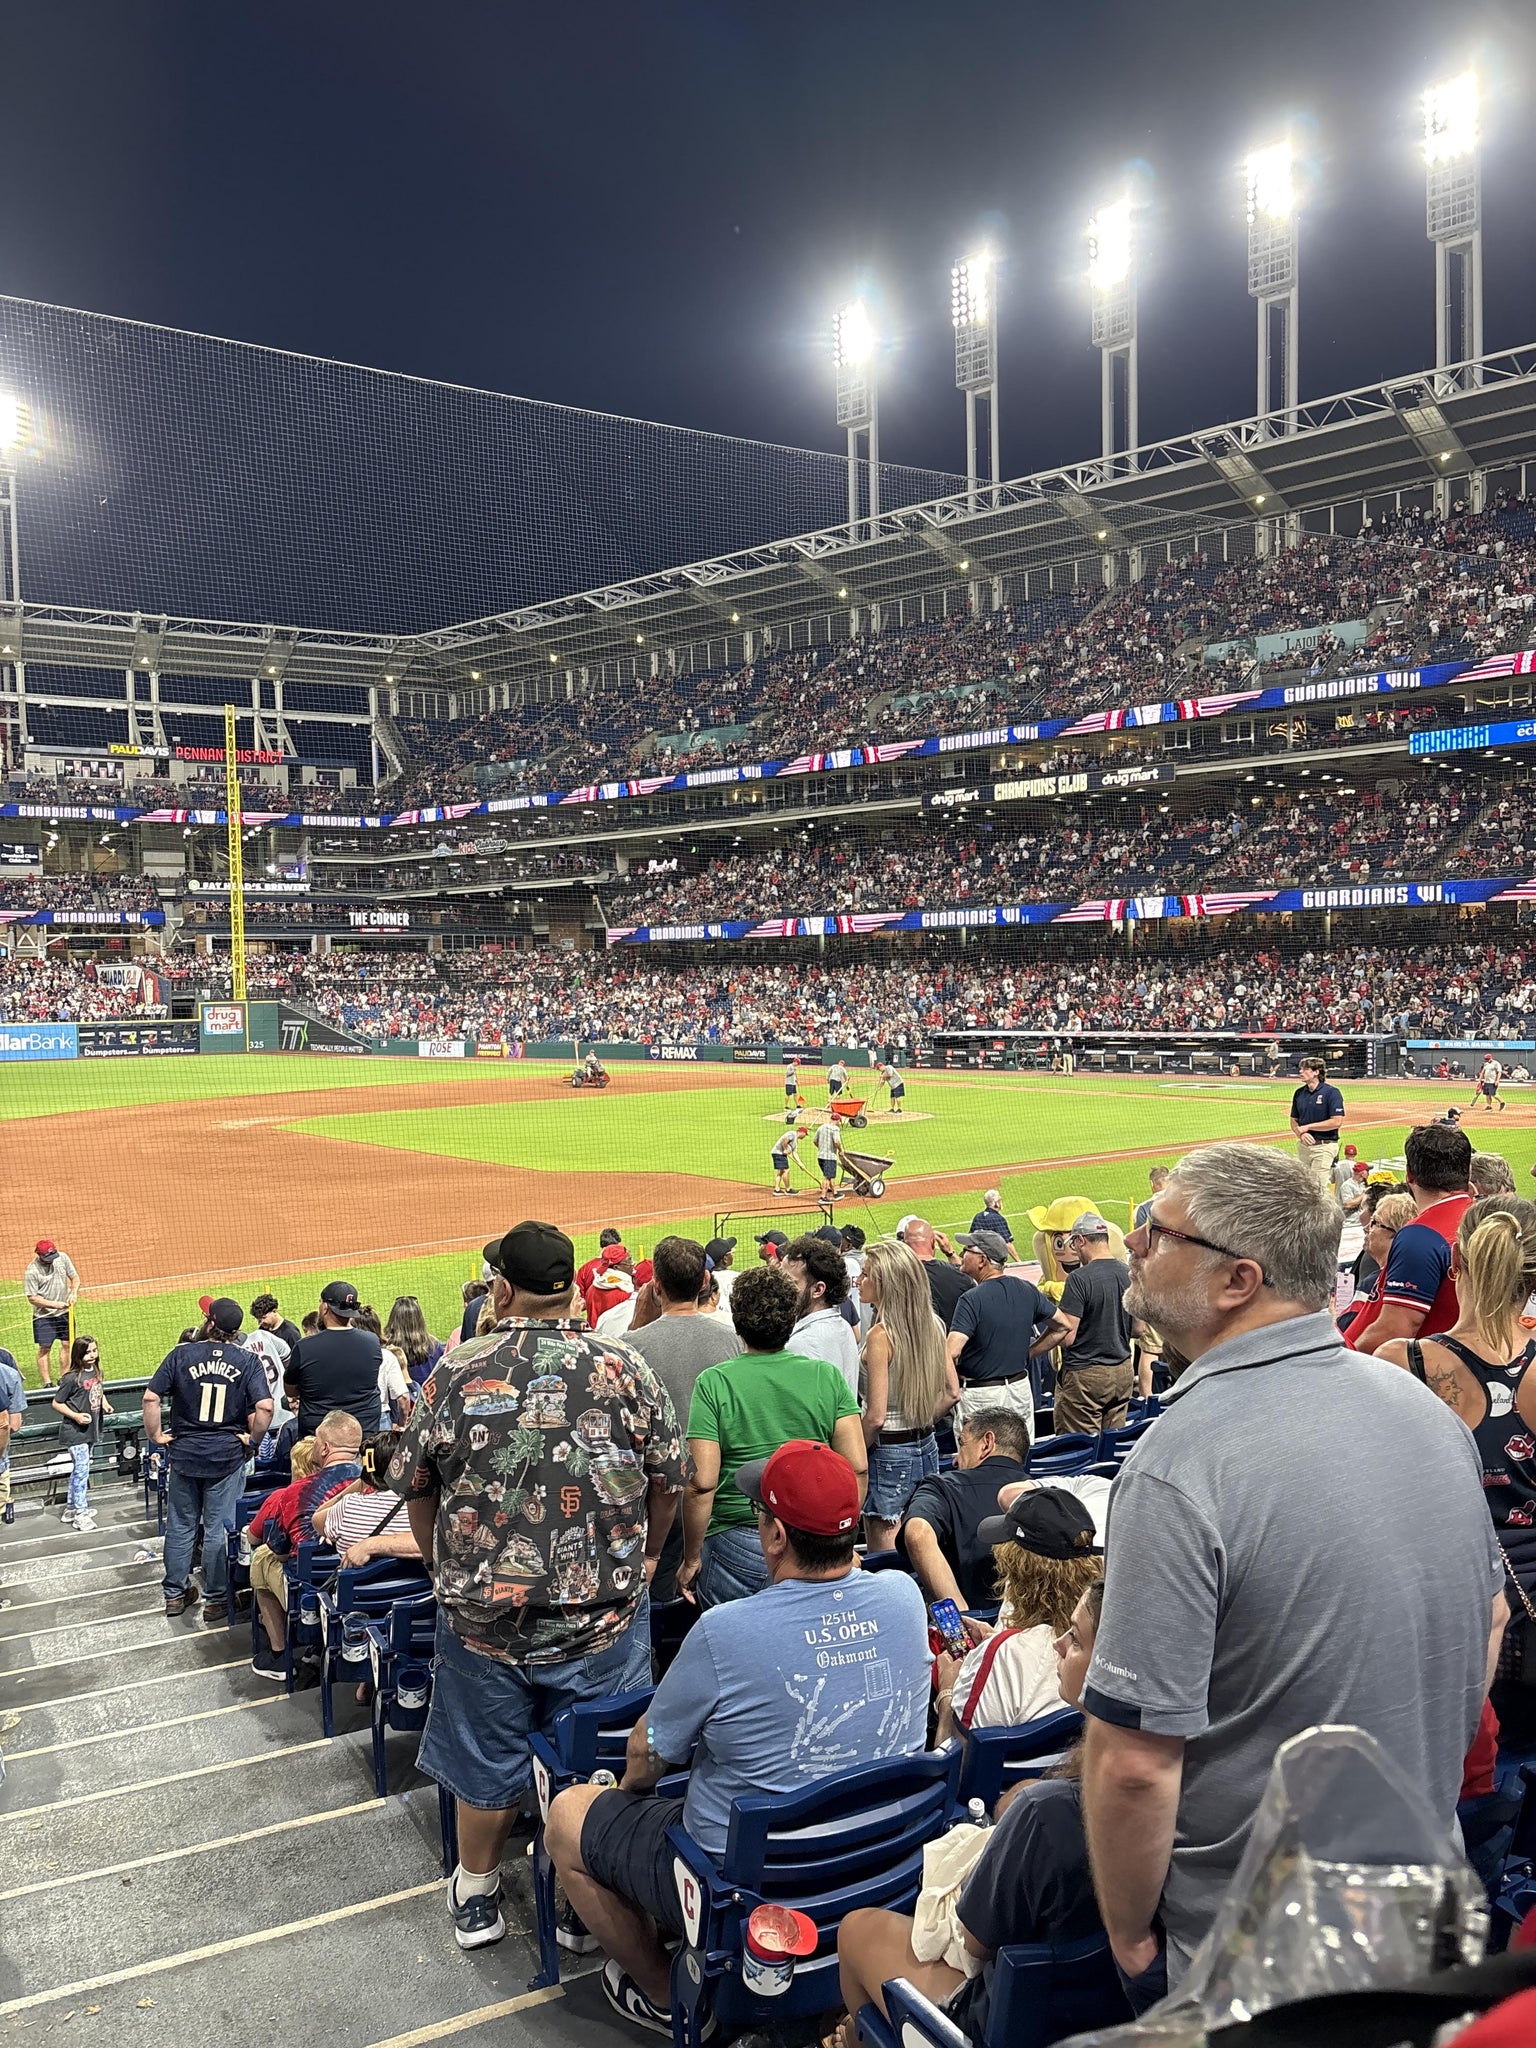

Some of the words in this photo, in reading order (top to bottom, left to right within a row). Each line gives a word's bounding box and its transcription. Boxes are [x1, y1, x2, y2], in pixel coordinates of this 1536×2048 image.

[1284, 676, 1378, 703] GUARDIANS
[1386, 672, 1421, 688] WIN
[940, 729, 1008, 751] GUARDIANS
[1013, 726, 1038, 740] WIN
[235, 750, 283, 764] DISTRICT
[687, 767, 739, 787] GUARDIANS
[1102, 774, 1129, 786] drug
[1130, 768, 1159, 782] mart
[994, 777, 1056, 801] CHAMPIONS
[1058, 773, 1088, 794] CLUB
[488, 797, 530, 812] GUARDIANS
[931, 795, 955, 806] drug
[955, 789, 979, 802] mart
[18, 806, 87, 819] GUARDIANS
[92, 808, 115, 820] WIN
[303, 816, 361, 828] GUARDIANS
[458, 842, 477, 855] kids
[263, 883, 311, 892] BREWERY
[1303, 886, 1408, 908] GUARDIANS
[53, 912, 120, 923] GUARDIANS
[349, 912, 368, 926] THE
[370, 912, 410, 926] CORNER
[922, 909, 997, 927] GUARDIANS
[649, 926, 705, 940] GUARDIANS
[207, 1008, 236, 1022] drug
[211, 1020, 241, 1031] mart
[249, 1041, 264, 1049] 325
[429, 1042, 452, 1056] ROSE
[188, 1358, 242, 1383] RAMÍREZ
[199, 1382, 227, 1423] 11
[557, 1541, 583, 1554] GIANTS
[560, 1550, 578, 1561] WIN!
[495, 1585, 515, 1595] GIANTS
[821, 1610, 857, 1626] 125TH
[804, 1627, 837, 1645] U.S.
[838, 1619, 879, 1640] OPEN
[816, 1645, 878, 1669] Oakmont
[1100, 1657, 1137, 1681] Columbia
[684, 1878, 695, 1920] C
